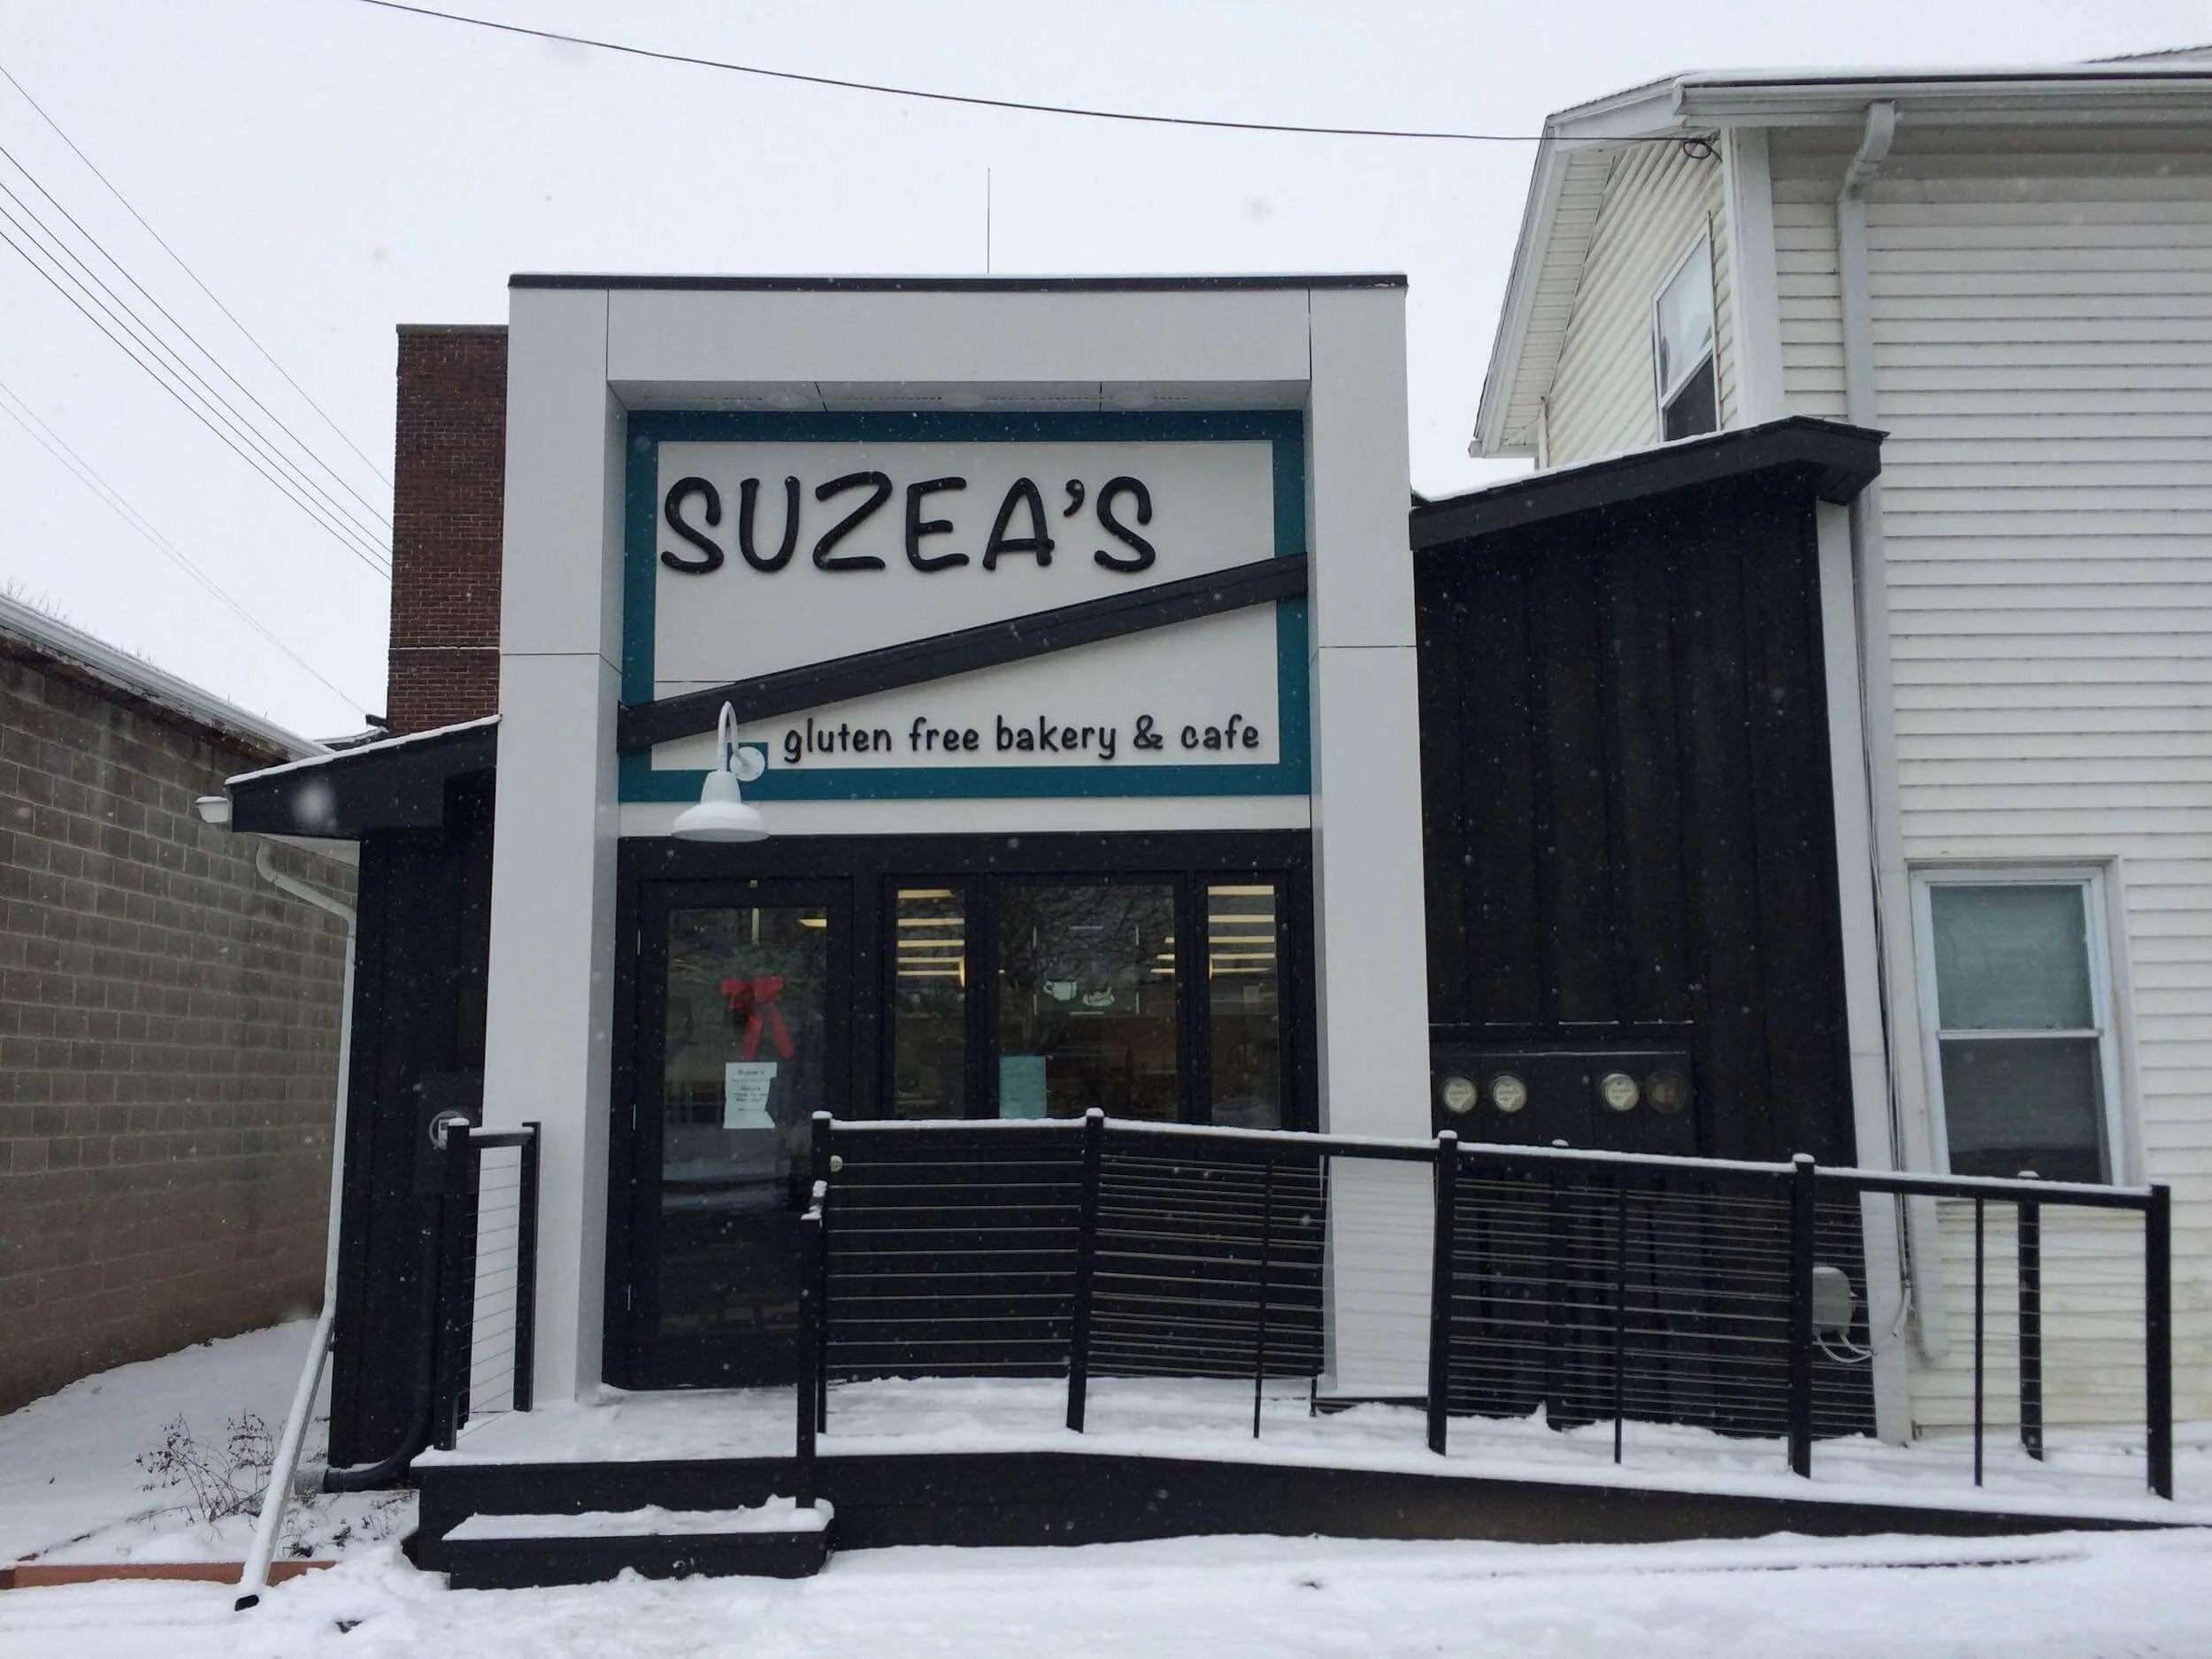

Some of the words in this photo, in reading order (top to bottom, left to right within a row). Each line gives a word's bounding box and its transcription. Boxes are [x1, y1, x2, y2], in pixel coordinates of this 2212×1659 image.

[660, 471, 1156, 575] SUZEA'S
[784, 718, 892, 764] gluten
[909, 716, 979, 752] free
[996, 715, 1117, 761] bakery
[1133, 715, 1164, 751] &
[1180, 714, 1260, 750] cafe
